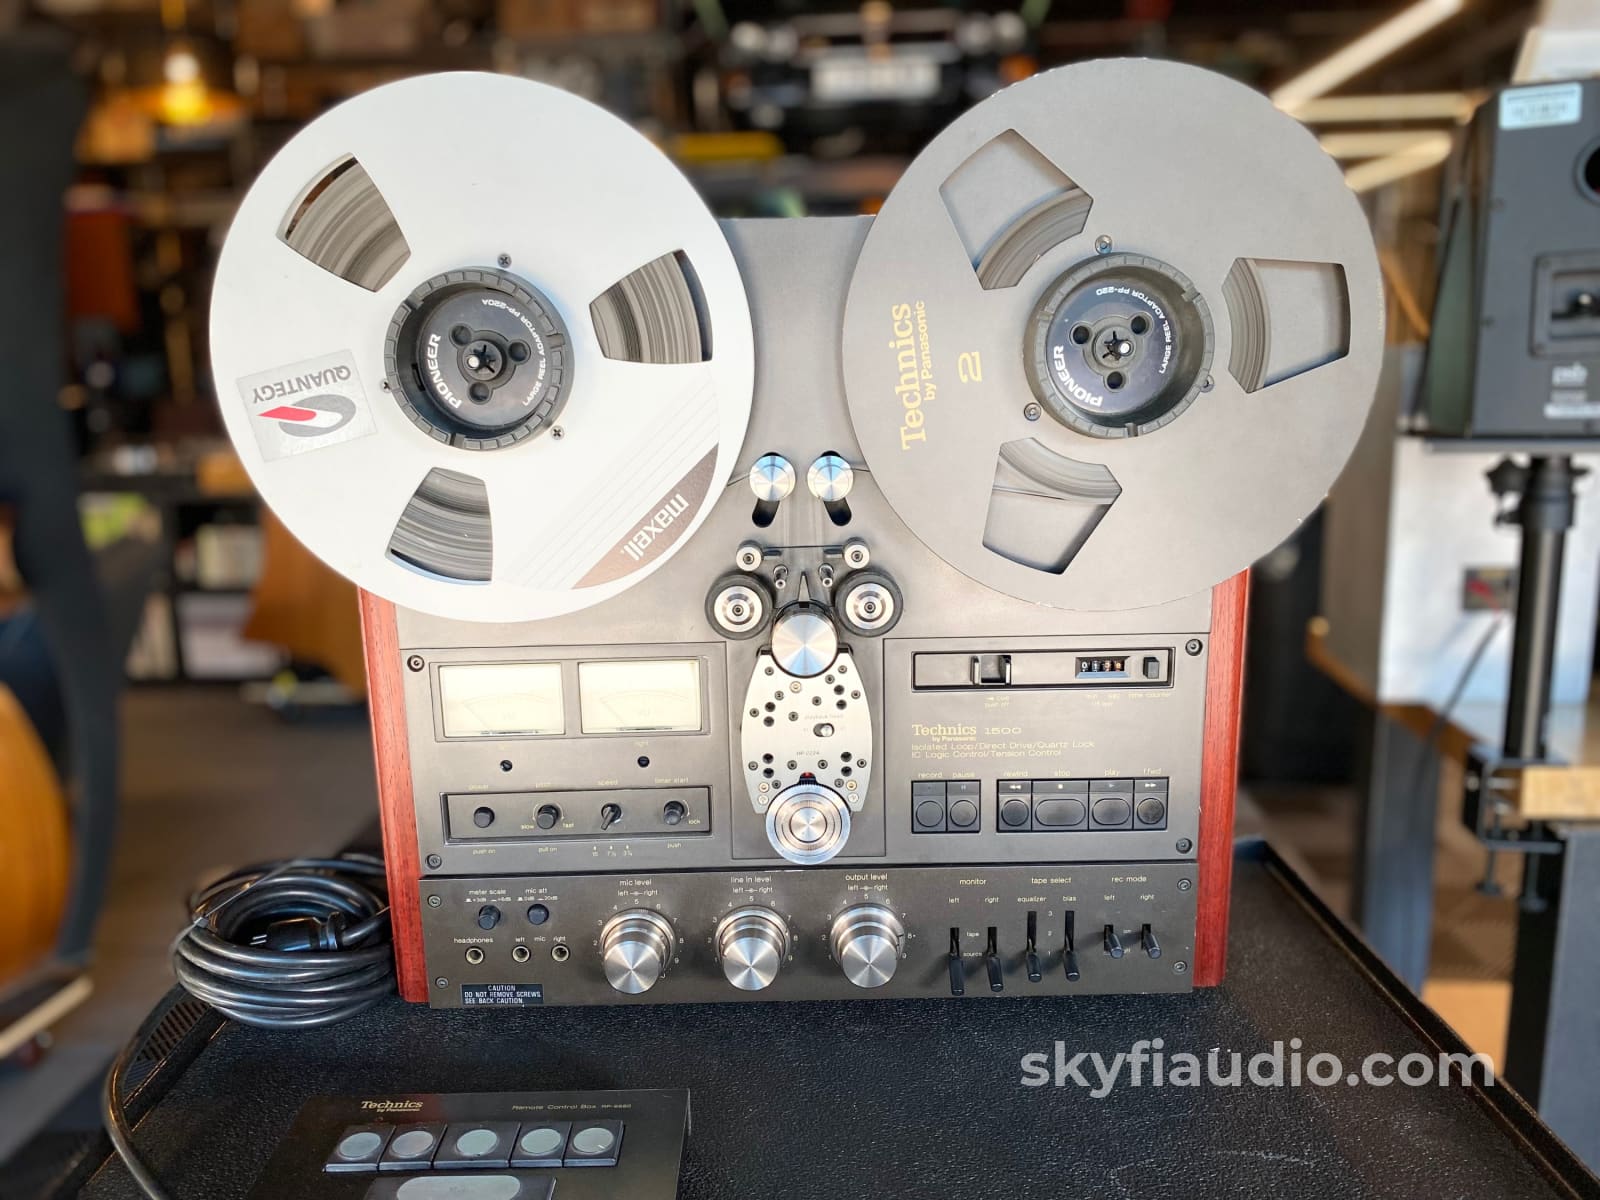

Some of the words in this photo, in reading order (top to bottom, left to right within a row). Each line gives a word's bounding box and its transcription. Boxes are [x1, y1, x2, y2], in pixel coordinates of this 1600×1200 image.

[1096, 286, 1130, 296] PP-220
[481, 299, 520, 317] PP-220A
[1132, 290, 1166, 319] ADAPTOR
[520, 314, 545, 356] ADAPTOR
[912, 300, 934, 378] Panasonic
[1162, 320, 1172, 342] REEL
[538, 358, 546, 380] REEL
[1158, 345, 1172, 374] LARGE
[426, 333, 461, 409] PIONEER
[888, 302, 926, 450] Technics
[1054, 346, 1104, 408] PIONEER
[252, 364, 352, 404] QUANTEGY
[522, 381, 542, 406] LARGE
[922, 382, 936, 400] by
[623, 493, 690, 561] maxell
[912, 724, 977, 736] Technics
[912, 743, 948, 751] Isolated
[1072, 740, 1096, 748] Lock
[926, 751, 950, 760] Logic
[1028, 749, 1062, 757] Control
[1054, 769, 1071, 778] stop
[1104, 768, 1120, 777] play
[730, 876, 744, 884] line
[846, 874, 868, 882] output
[360, 1100, 424, 1109] Technics
